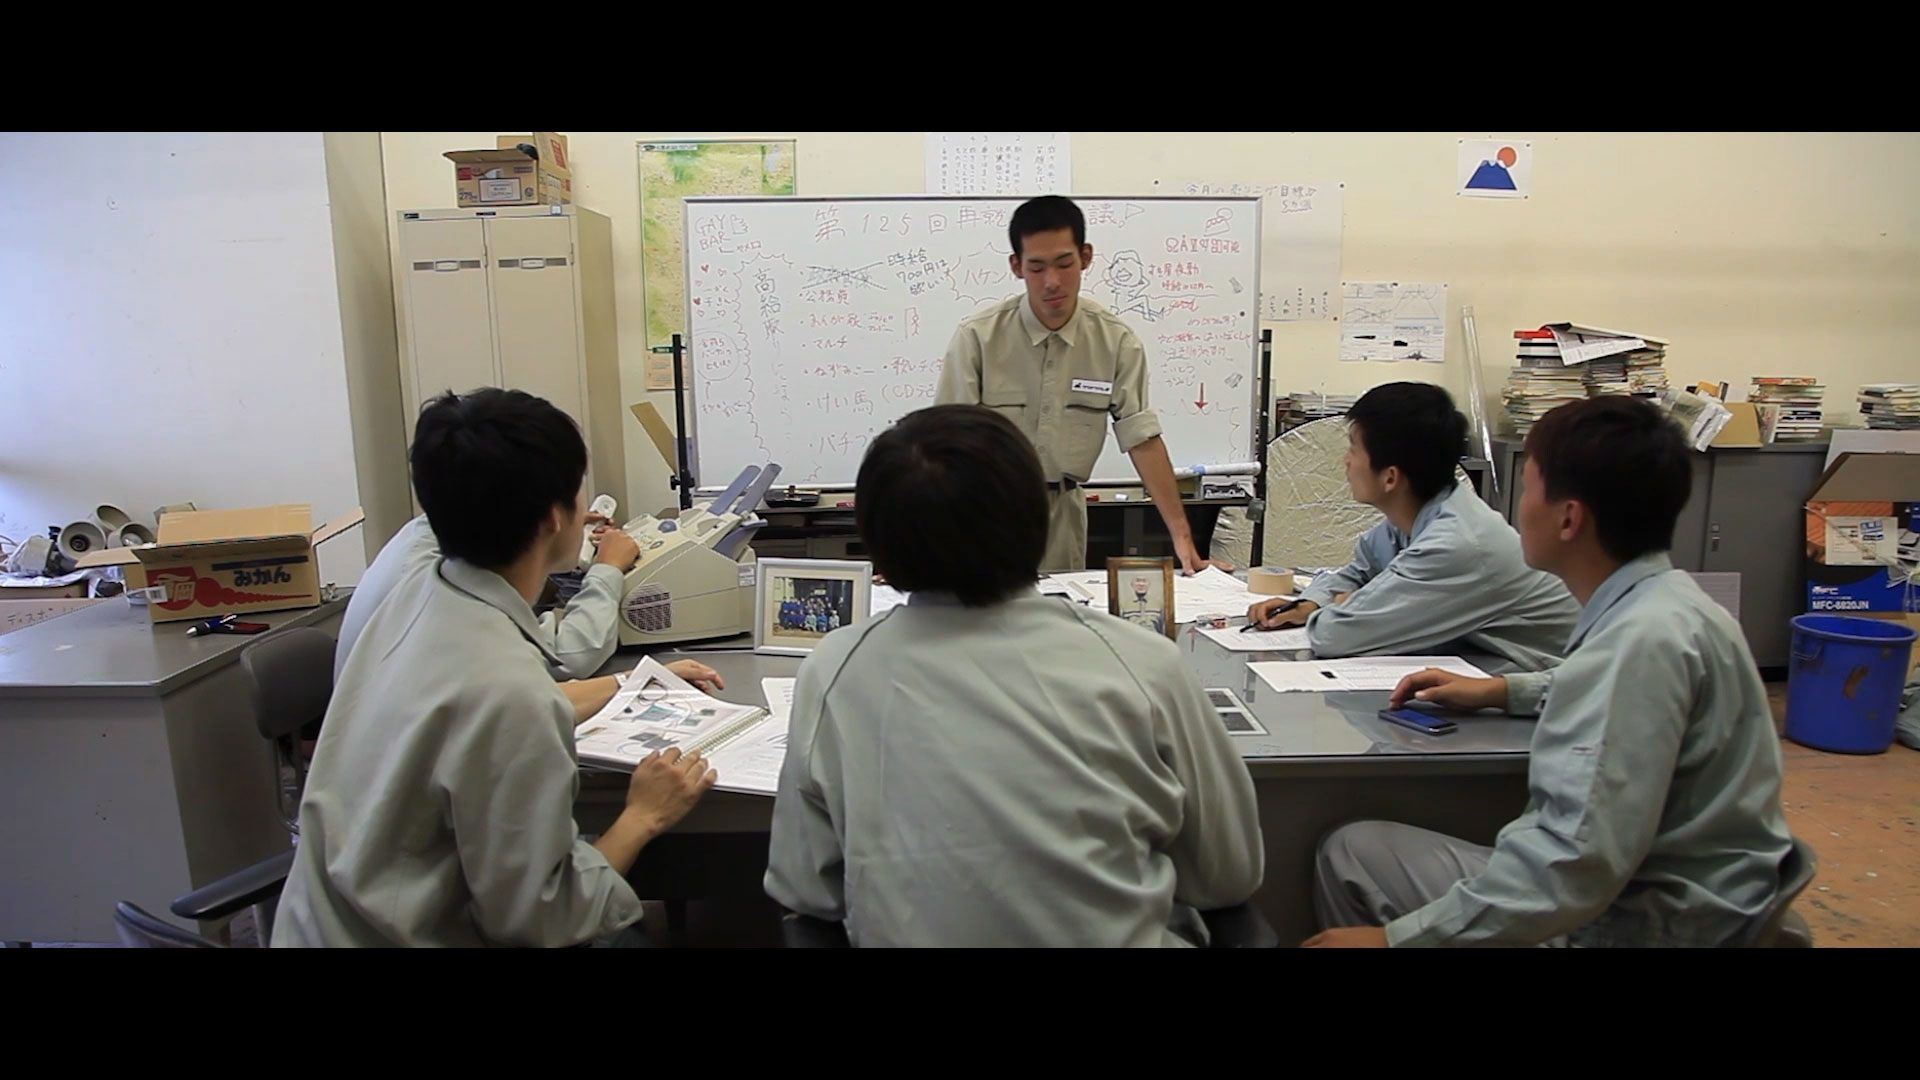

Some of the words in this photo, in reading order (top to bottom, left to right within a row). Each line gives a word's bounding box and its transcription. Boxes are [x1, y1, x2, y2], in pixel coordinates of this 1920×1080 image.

[699, 230, 731, 251] BAR
[233, 566, 292, 587] みかん
